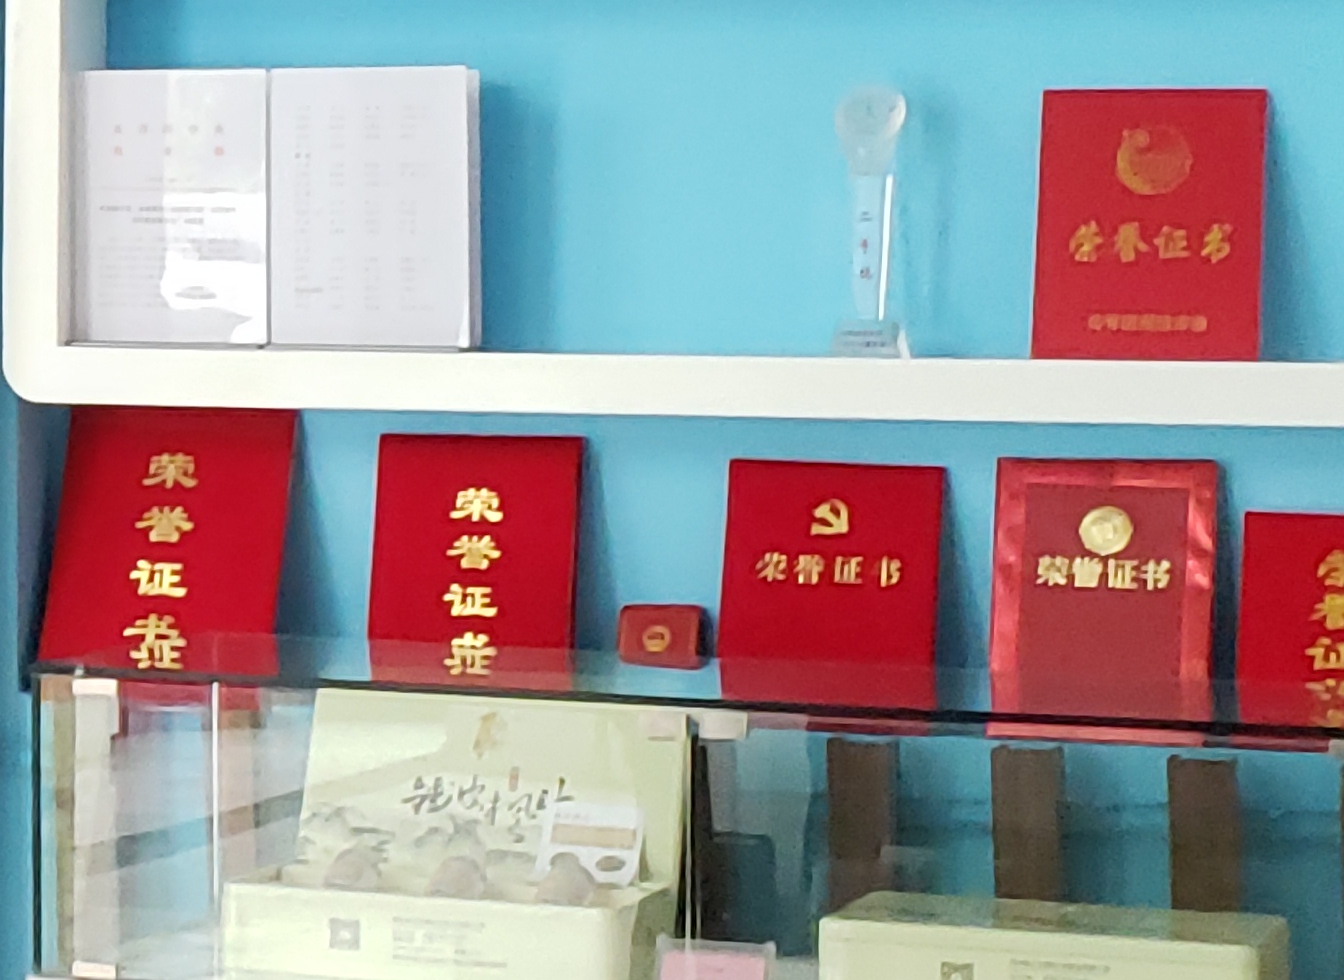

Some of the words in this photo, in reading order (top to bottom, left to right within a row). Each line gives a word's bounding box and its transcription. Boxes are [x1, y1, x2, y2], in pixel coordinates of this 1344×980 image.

[1068, 220, 1234, 264] 荣誉证书
[122, 452, 198, 667] 荣誉证书
[754, 551, 902, 588] 荣誉证书
[1035, 554, 1172, 590] 荣誉证书
